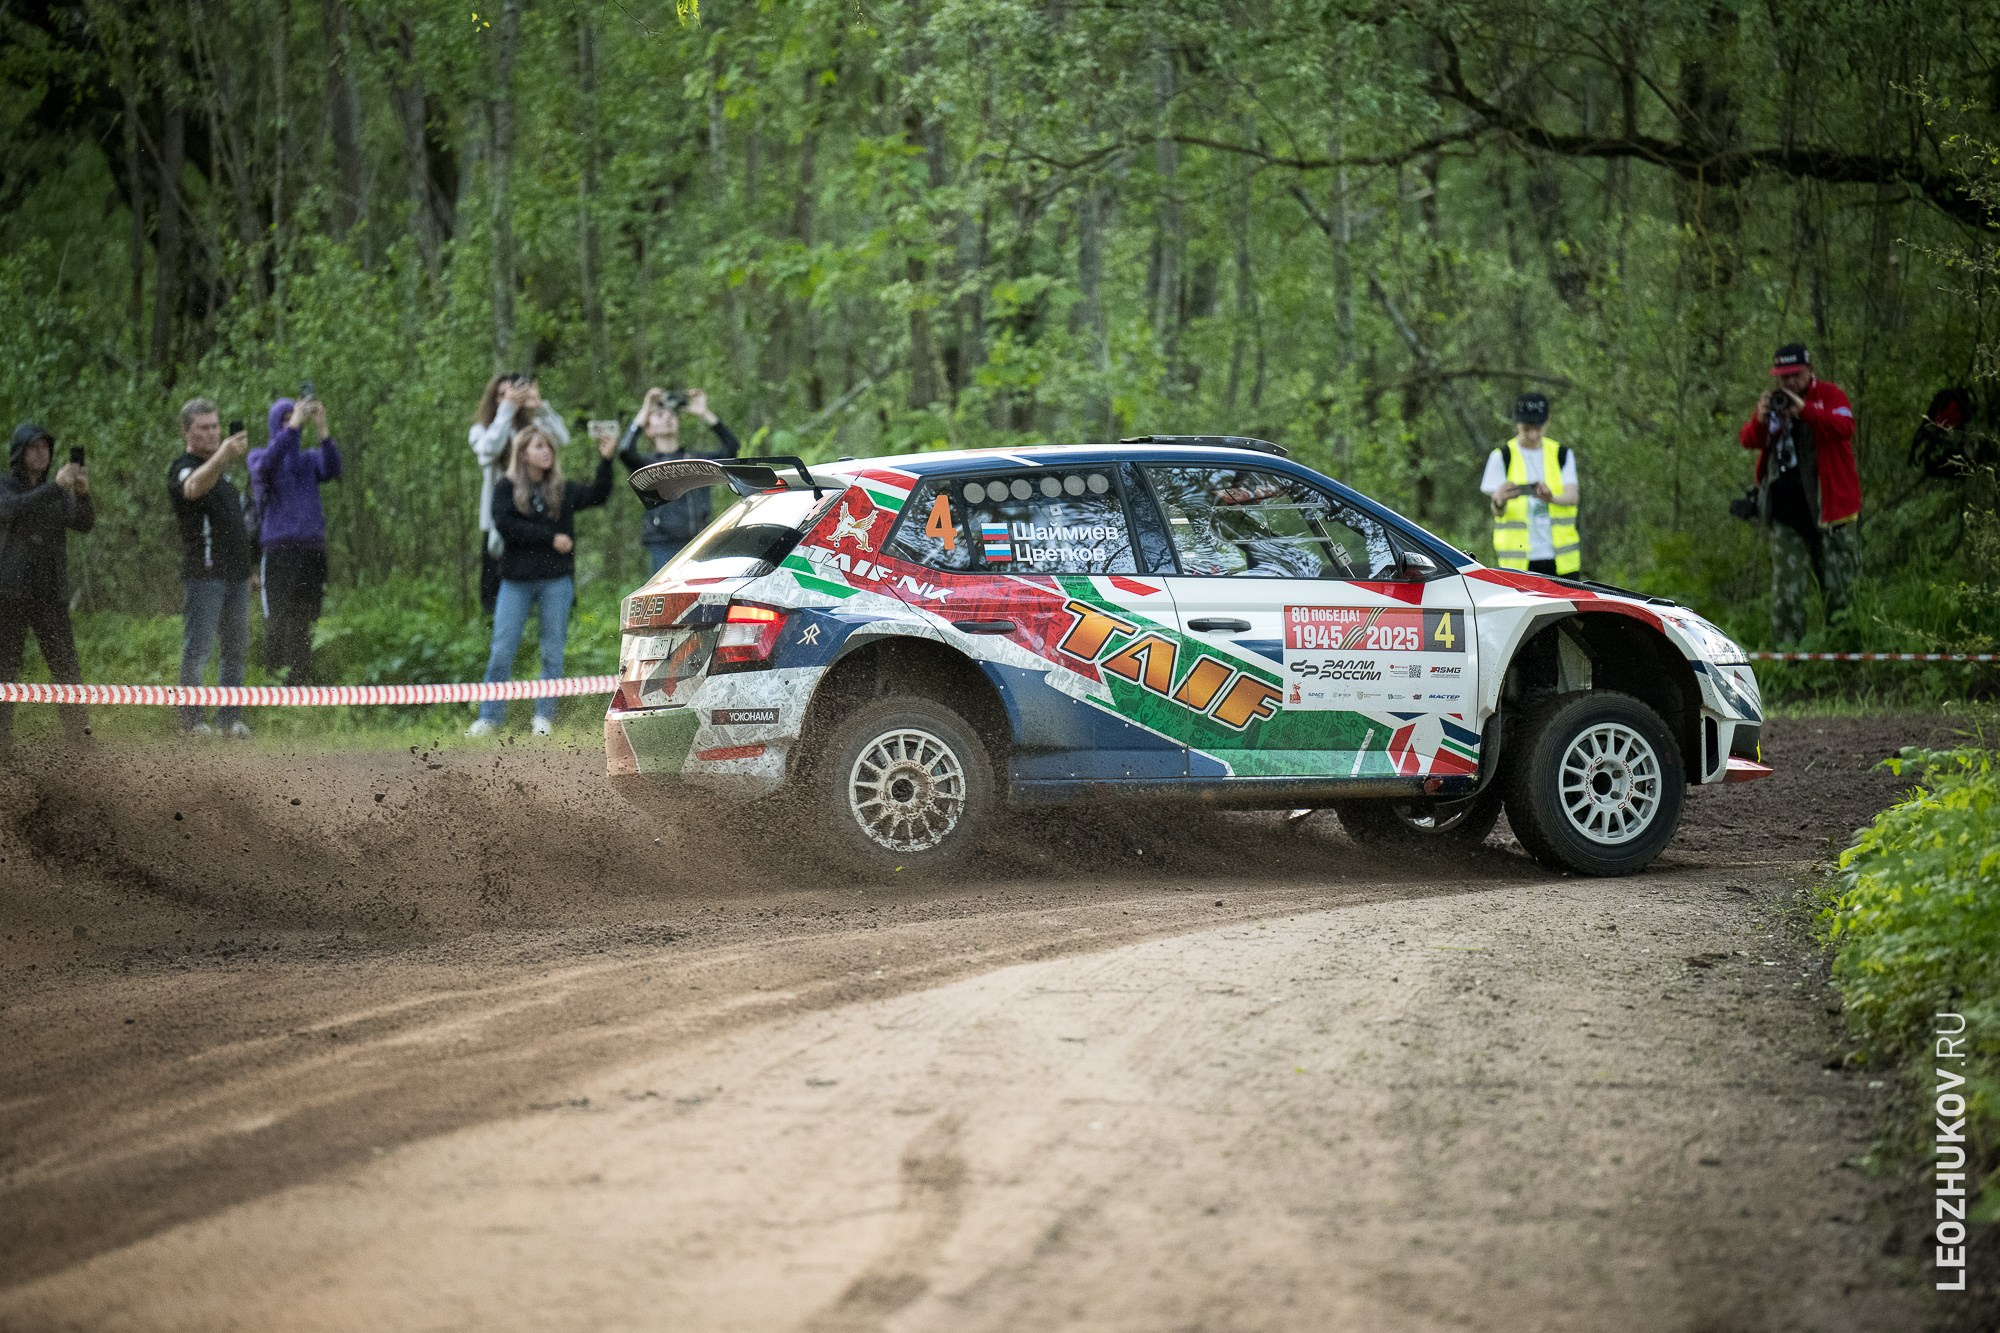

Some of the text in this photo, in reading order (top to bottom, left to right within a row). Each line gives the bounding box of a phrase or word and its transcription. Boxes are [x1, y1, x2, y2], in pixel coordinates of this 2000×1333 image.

[925, 494, 957, 550] 4
[1012, 523, 1119, 541] Шаймиев
[1015, 543, 1107, 565] Цветков
[1291, 607, 1360, 624] 80 ПОБЕДА!
[1292, 625, 1419, 650] 1945 2025
[1434, 612, 1455, 649] 4
[1057, 598, 1283, 732] TAIF
[1322, 659, 1376, 670] РАЛЛИ
[1318, 670, 1382, 681] РОССИИ
[728, 711, 775, 722] YOKOHAMA
